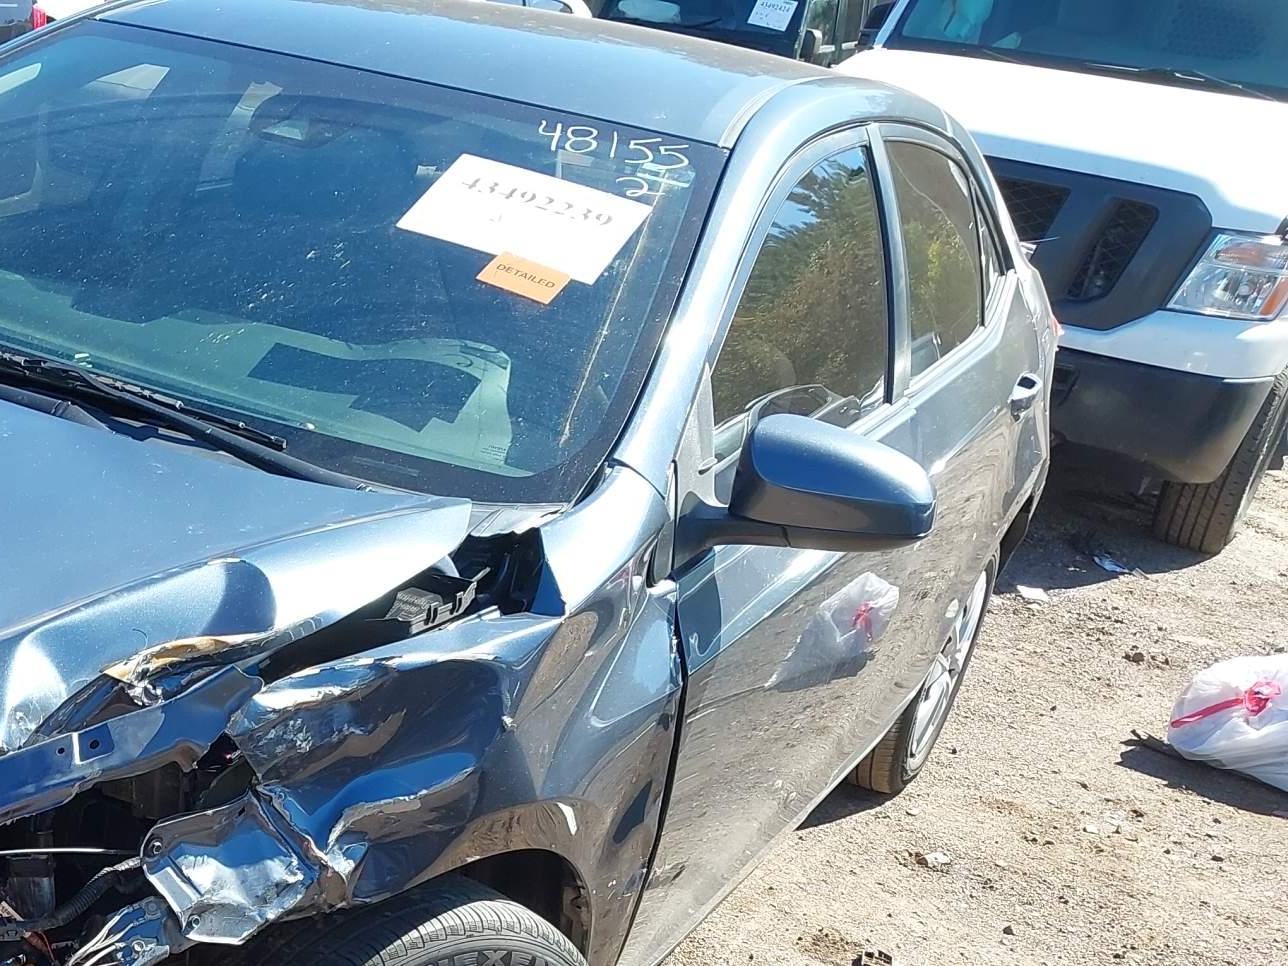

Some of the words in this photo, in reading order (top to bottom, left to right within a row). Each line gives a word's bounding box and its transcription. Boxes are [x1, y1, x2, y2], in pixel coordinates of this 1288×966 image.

[538, 119, 690, 170] 48155
[461, 177, 614, 227] 43492239
[495, 262, 557, 290] DETAILED
